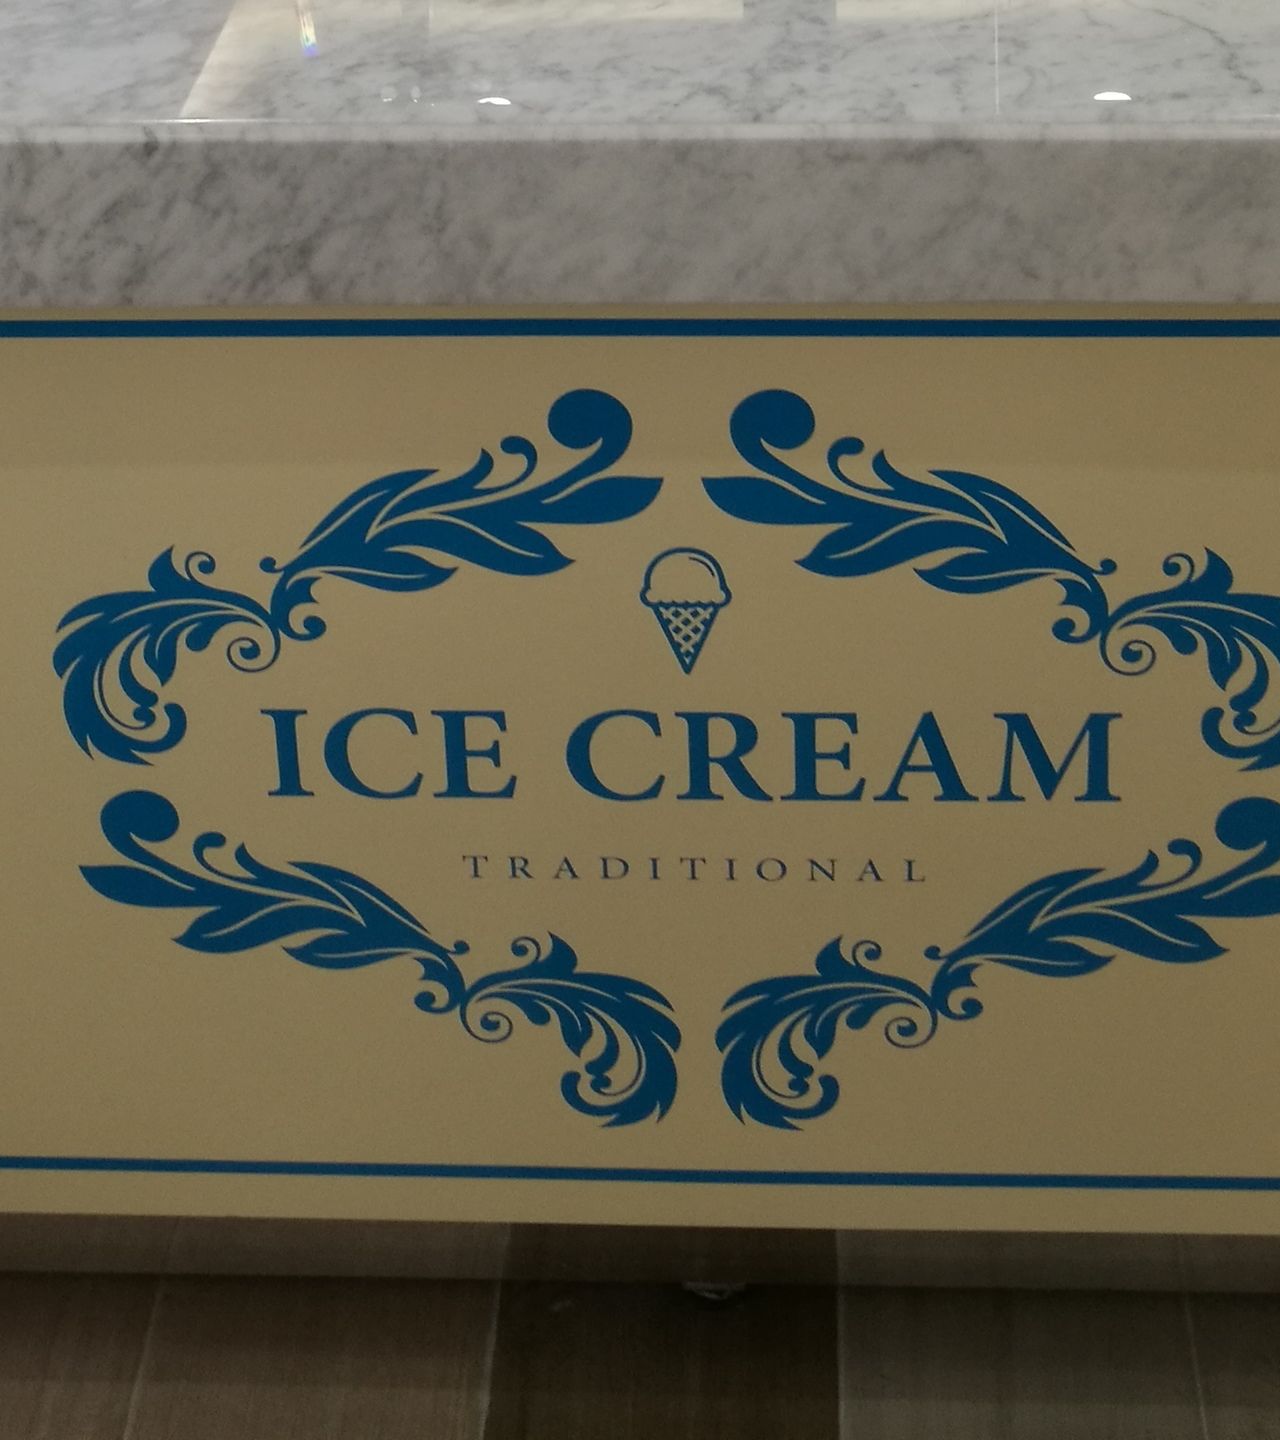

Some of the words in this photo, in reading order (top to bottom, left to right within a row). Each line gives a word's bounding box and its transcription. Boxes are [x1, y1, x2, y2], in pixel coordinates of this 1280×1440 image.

[260, 707, 519, 801] ICE
[565, 708, 1124, 804] CREAM
[462, 853, 928, 884] TRADITIONAL
